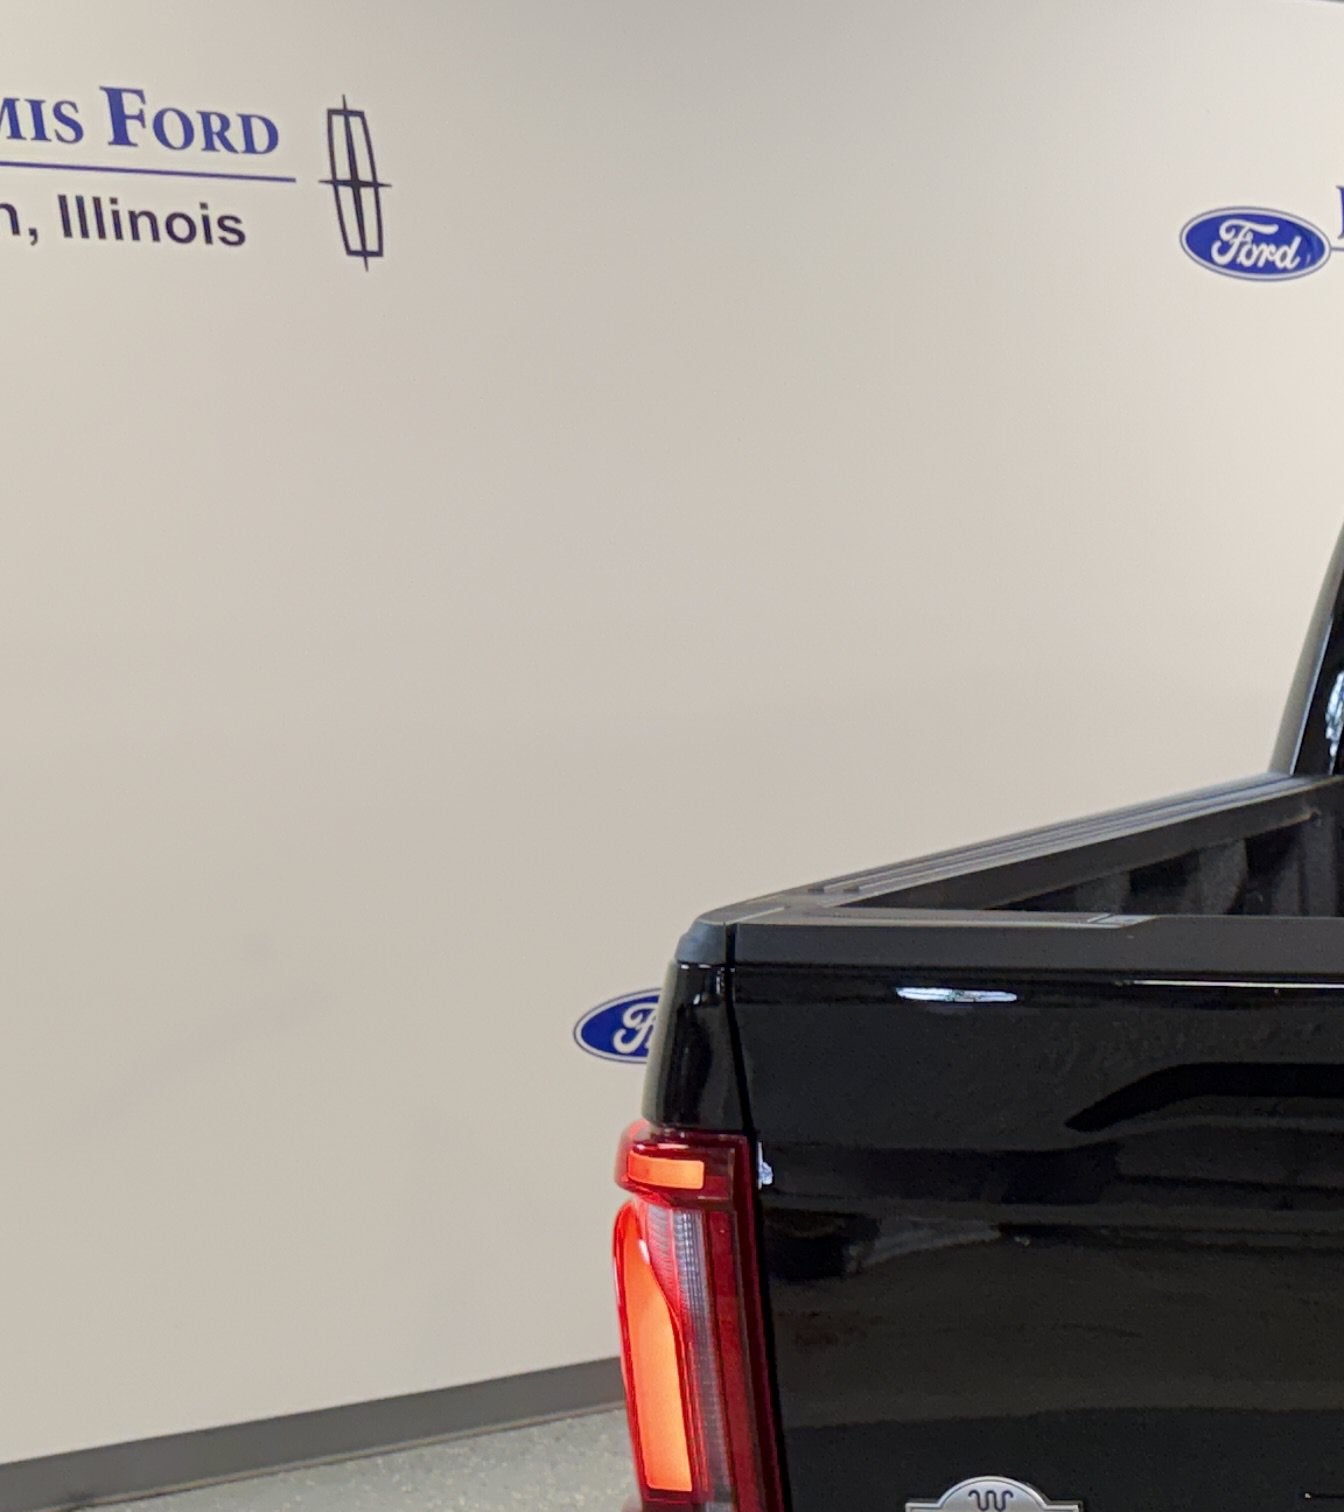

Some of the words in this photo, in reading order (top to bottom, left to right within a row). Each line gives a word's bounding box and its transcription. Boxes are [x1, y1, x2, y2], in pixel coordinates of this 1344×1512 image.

[99, 85, 280, 156] FORD
[57, 193, 247, 247] Illinois
[1211, 218, 1302, 270] Ford
